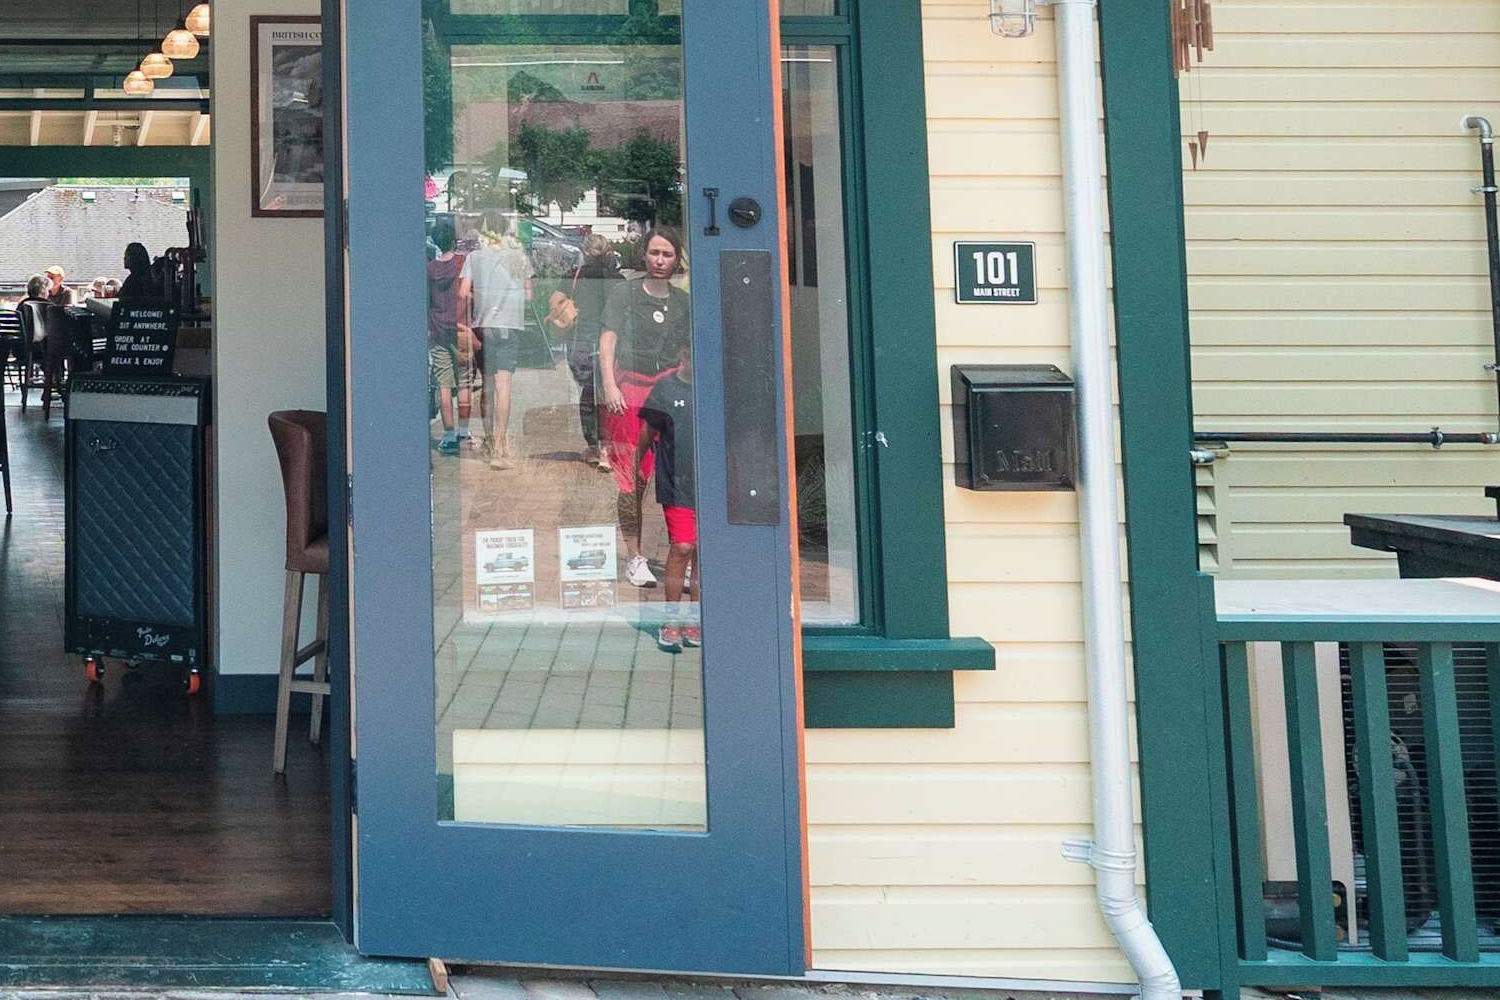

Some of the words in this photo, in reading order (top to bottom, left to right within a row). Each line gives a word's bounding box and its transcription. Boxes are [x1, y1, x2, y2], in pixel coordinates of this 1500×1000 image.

[972, 251, 1019, 285] 101
[973, 287, 993, 297] MAIN
[993, 287, 1021, 297] STREET
[119, 321, 130, 329] SIT
[114, 335, 135, 343] ORDER
[140, 335, 151, 343] AT
[115, 343, 129, 351] THE
[131, 343, 161, 351] COUNTER
[110, 357, 132, 365] RELAX
[143, 357, 164, 366] ENJOY
